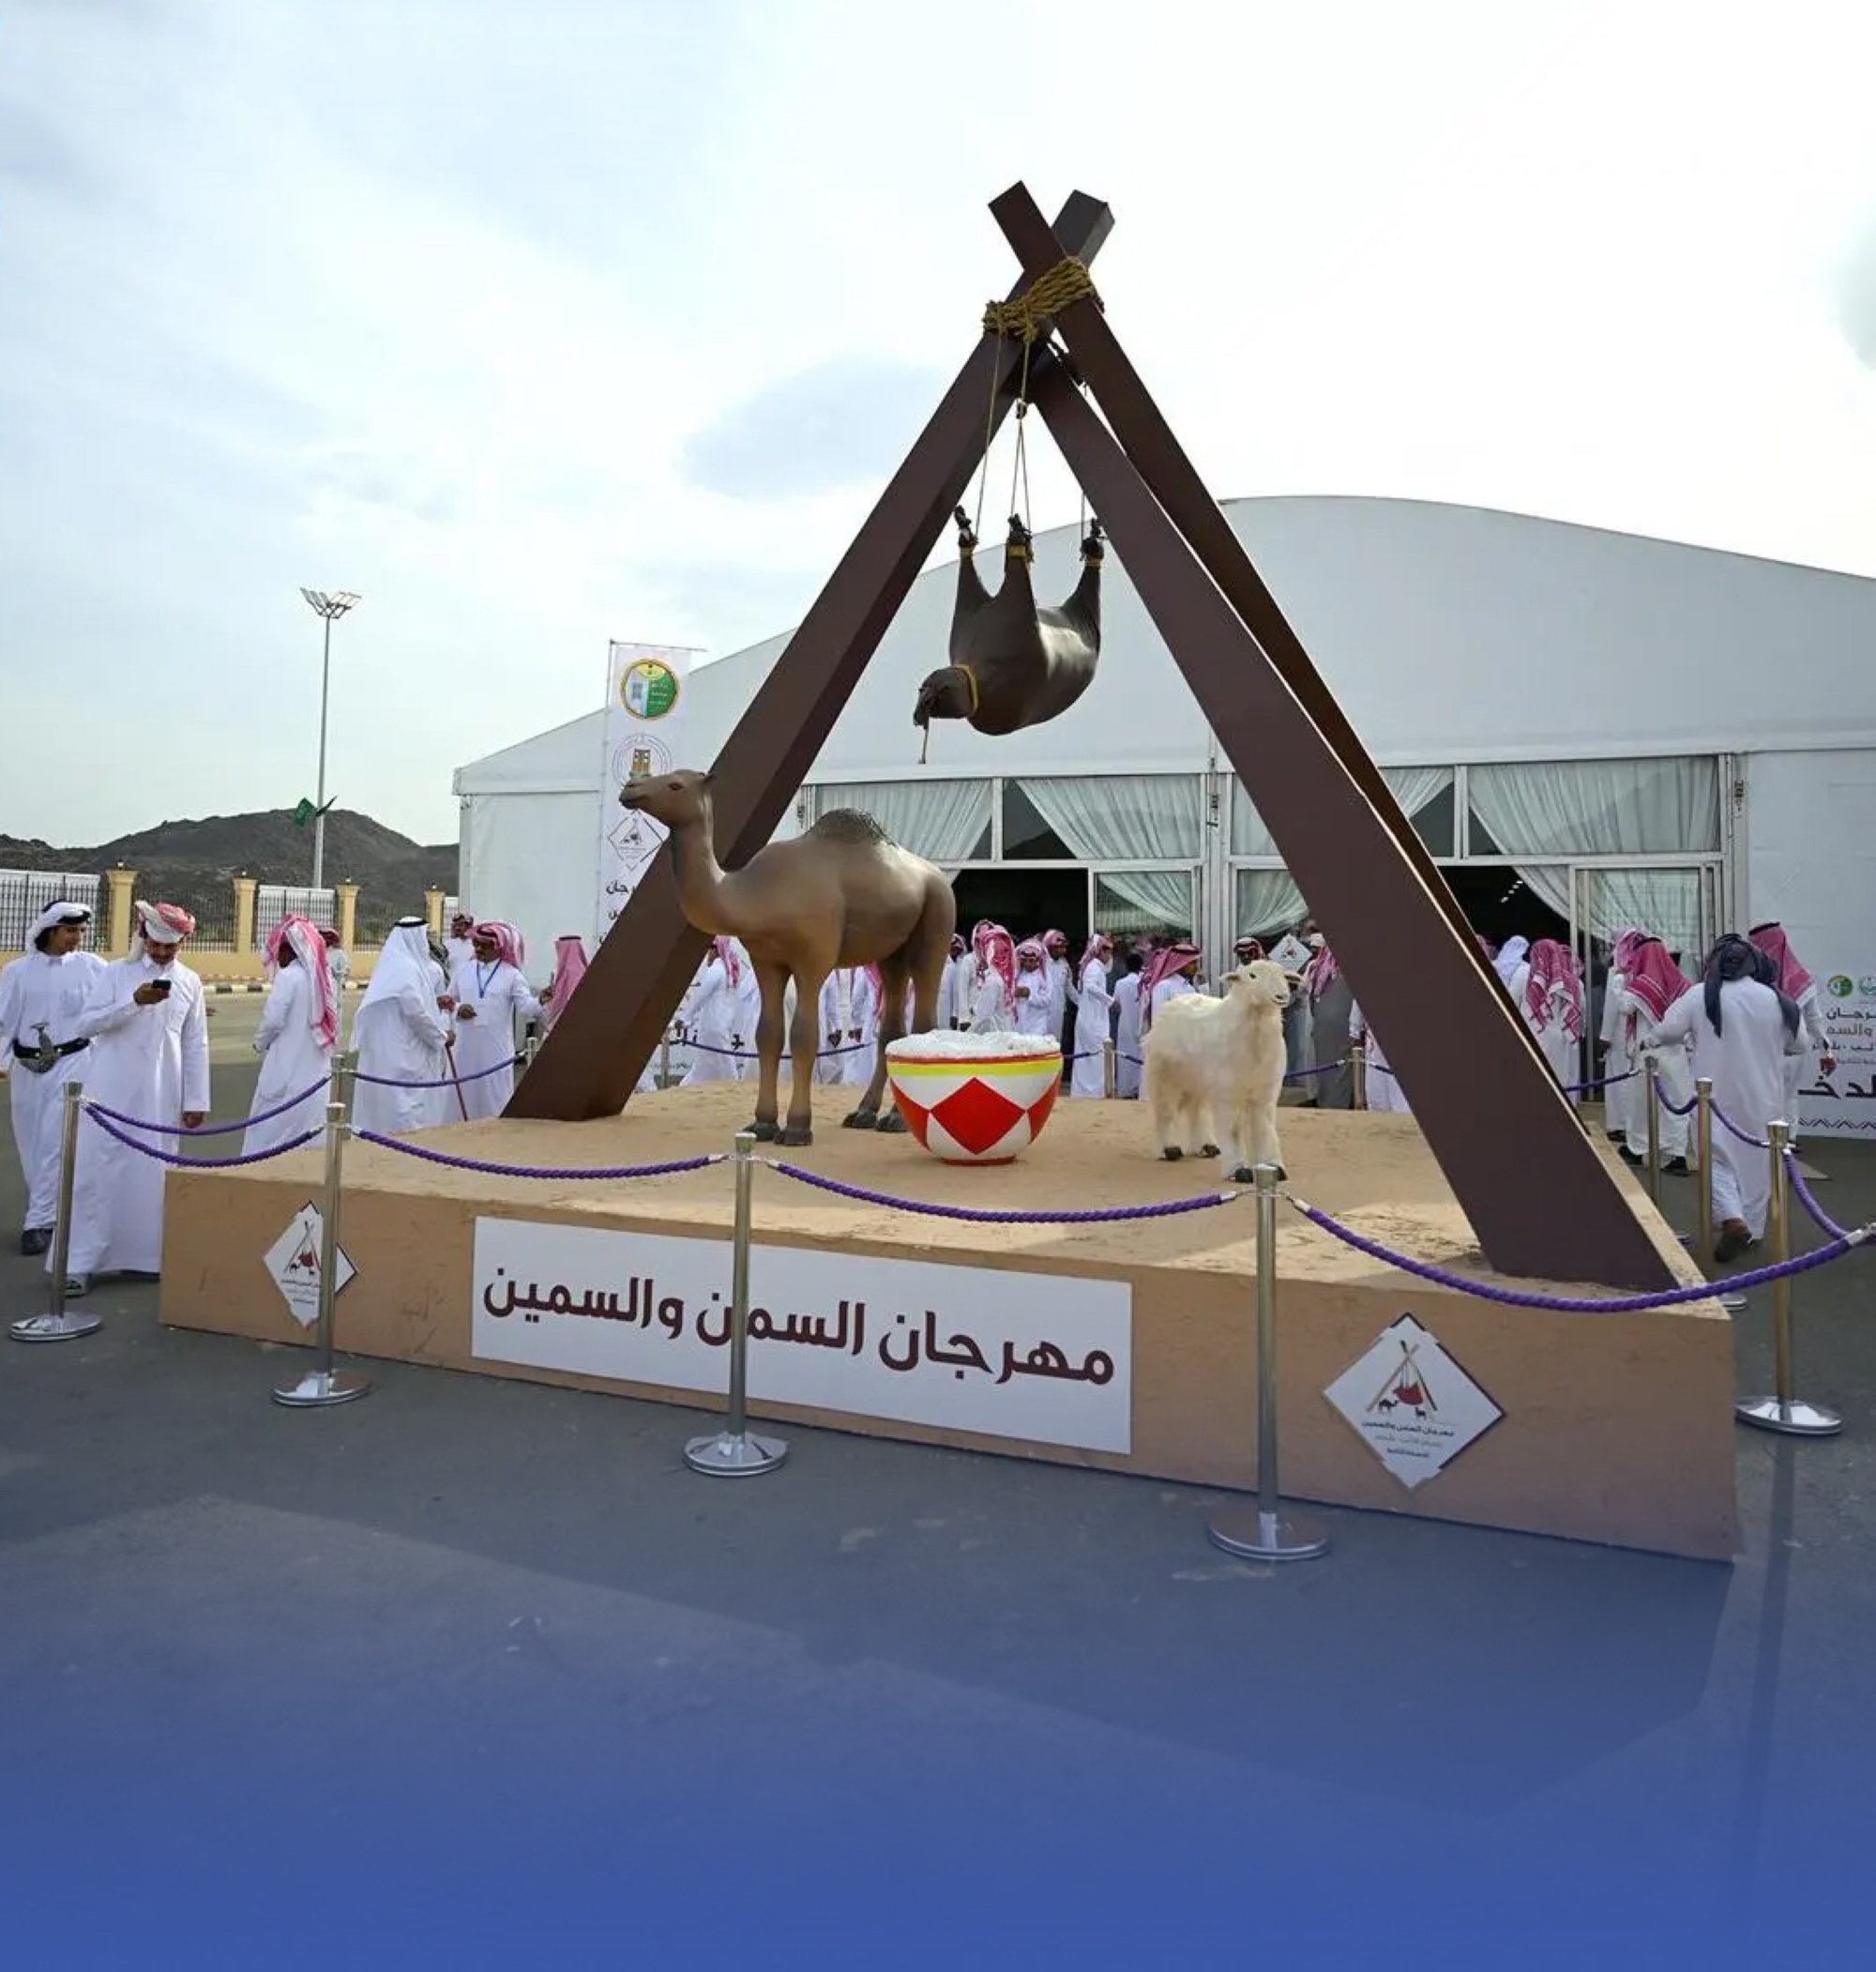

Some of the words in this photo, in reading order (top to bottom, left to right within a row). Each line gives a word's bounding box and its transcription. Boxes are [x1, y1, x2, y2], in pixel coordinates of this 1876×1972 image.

[483, 1267, 684, 1340] والسمين
[696, 1292, 865, 1356] السمن
[880, 1311, 1115, 1385] مهرجان
